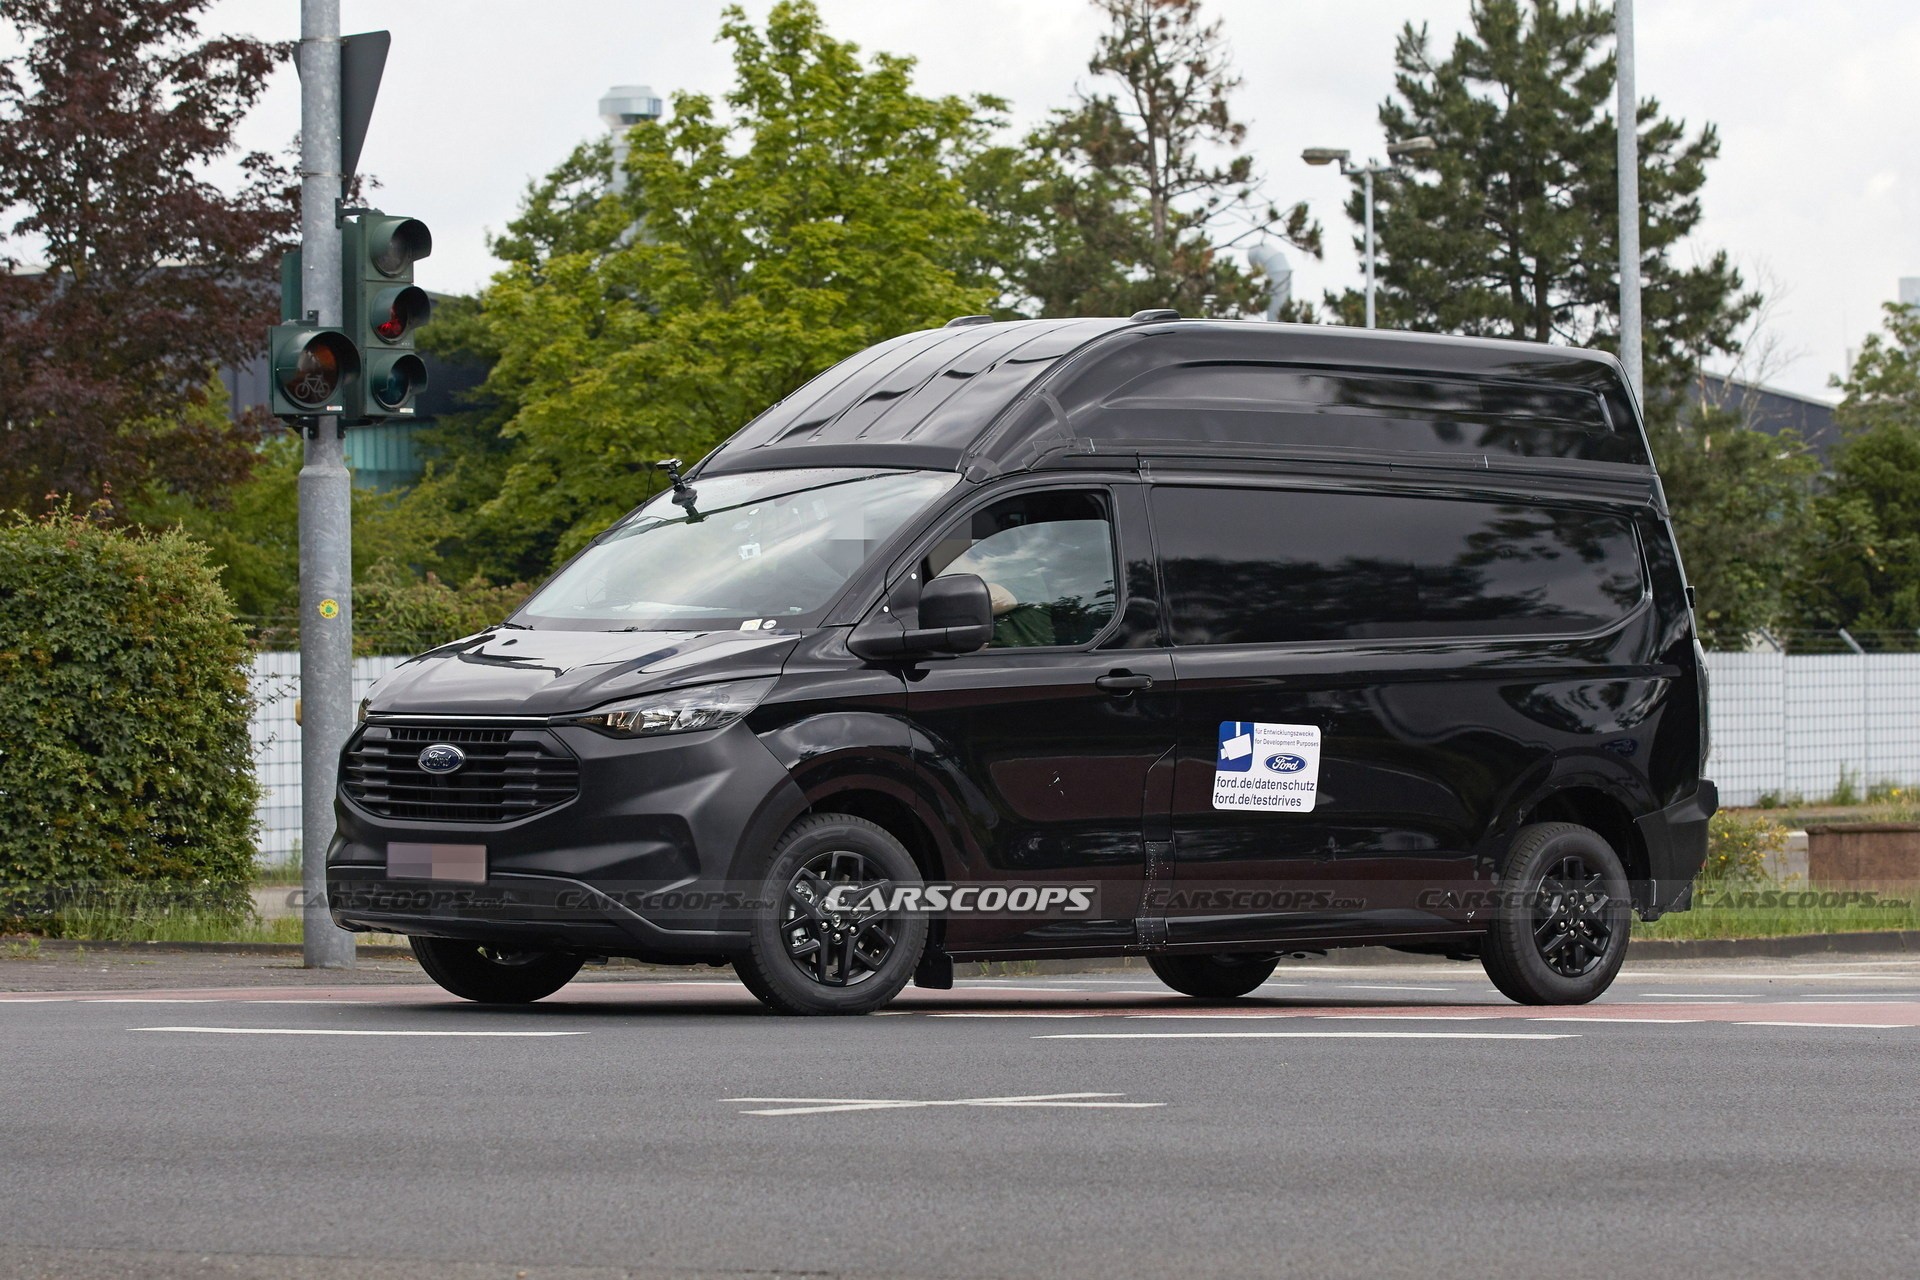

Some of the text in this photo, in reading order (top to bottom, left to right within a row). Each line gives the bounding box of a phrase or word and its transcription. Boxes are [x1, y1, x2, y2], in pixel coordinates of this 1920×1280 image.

[1272, 755, 1299, 770] Ford
[1216, 776, 1315, 791] ford.de/datenschutz
[1214, 792, 1302, 807] ford.de/testdrives
